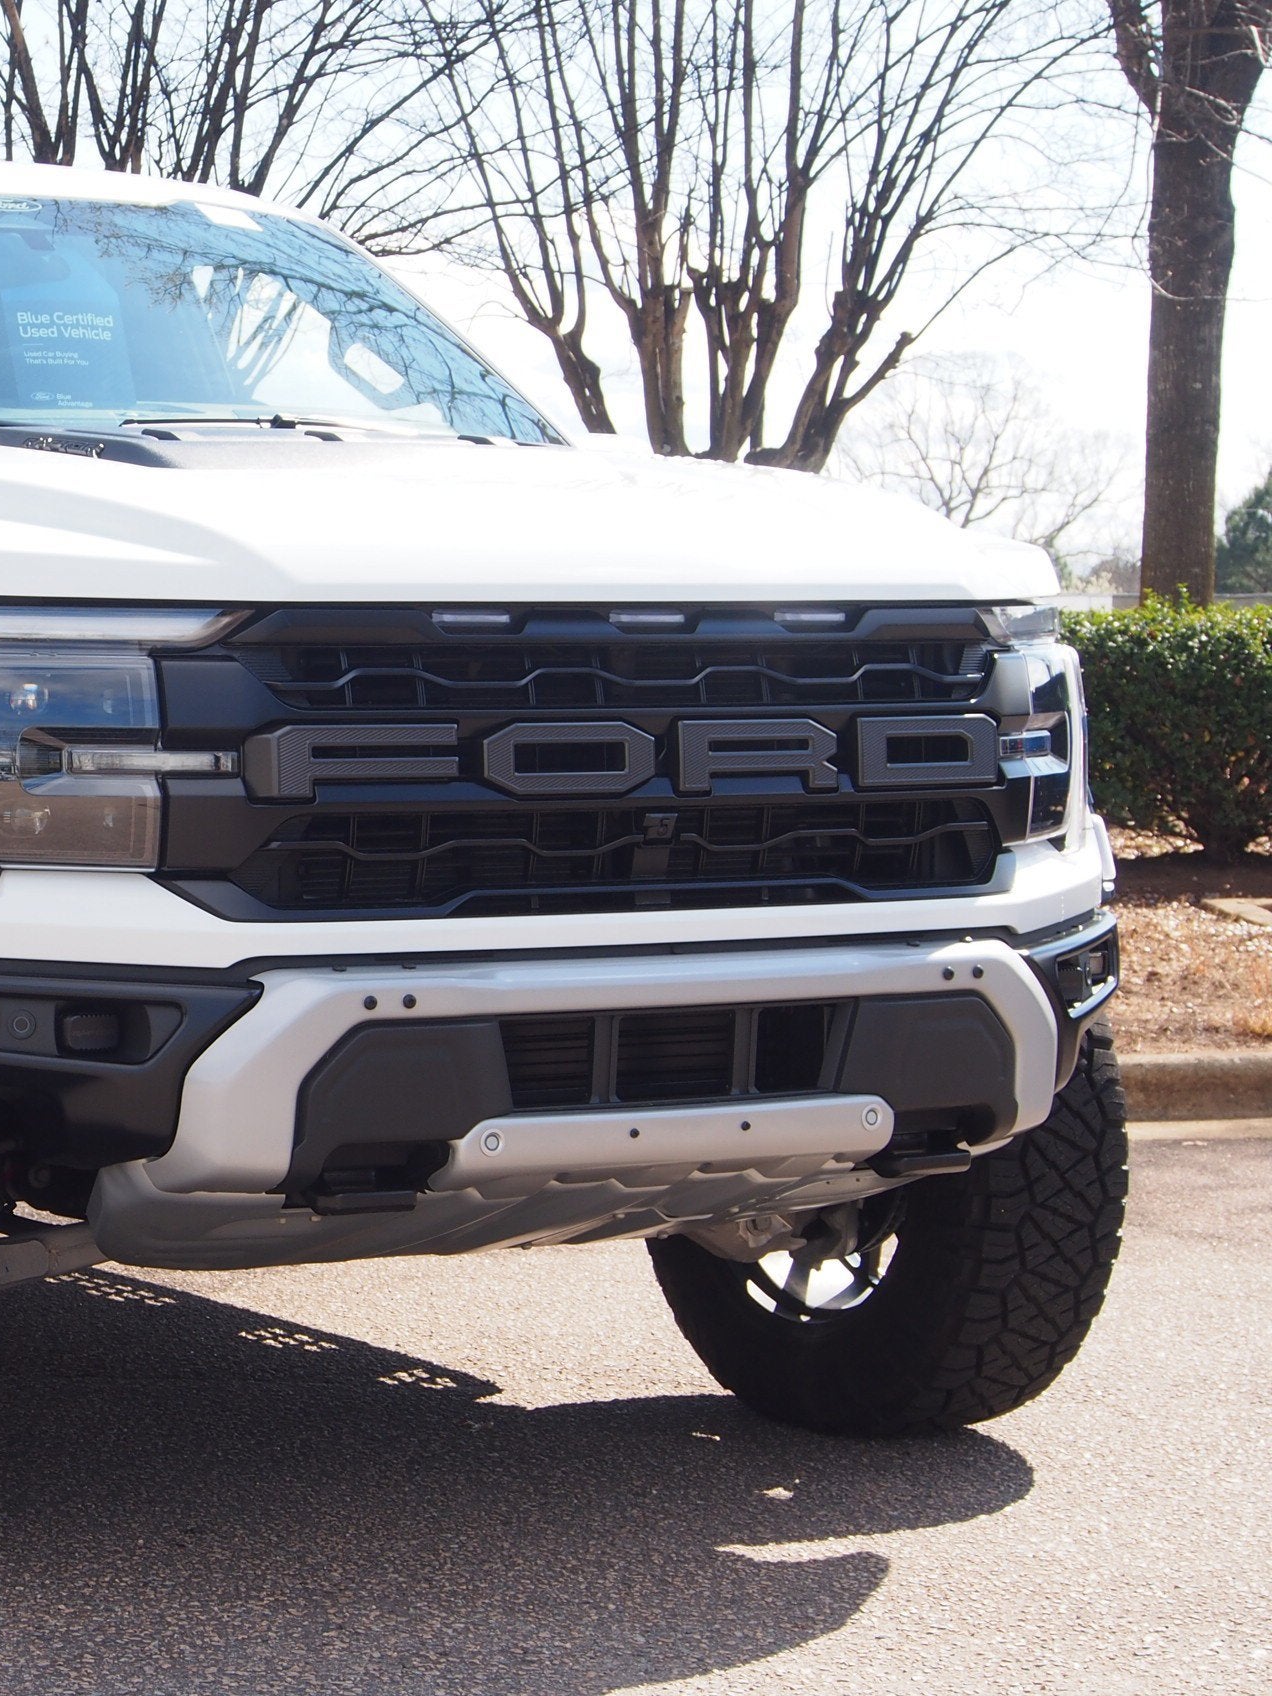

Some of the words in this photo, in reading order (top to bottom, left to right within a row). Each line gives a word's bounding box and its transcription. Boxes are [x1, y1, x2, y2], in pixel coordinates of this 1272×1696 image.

[16, 311, 50, 324] Blue
[53, 312, 114, 327] Certified
[19, 325, 58, 338] Used
[61, 326, 112, 341] Vehicle
[23, 350, 42, 358] Used
[55, 351, 79, 359] Buying
[64, 358, 75, 366] For
[57, 400, 94, 408] Advantage
[245, 713, 998, 799] FORD
